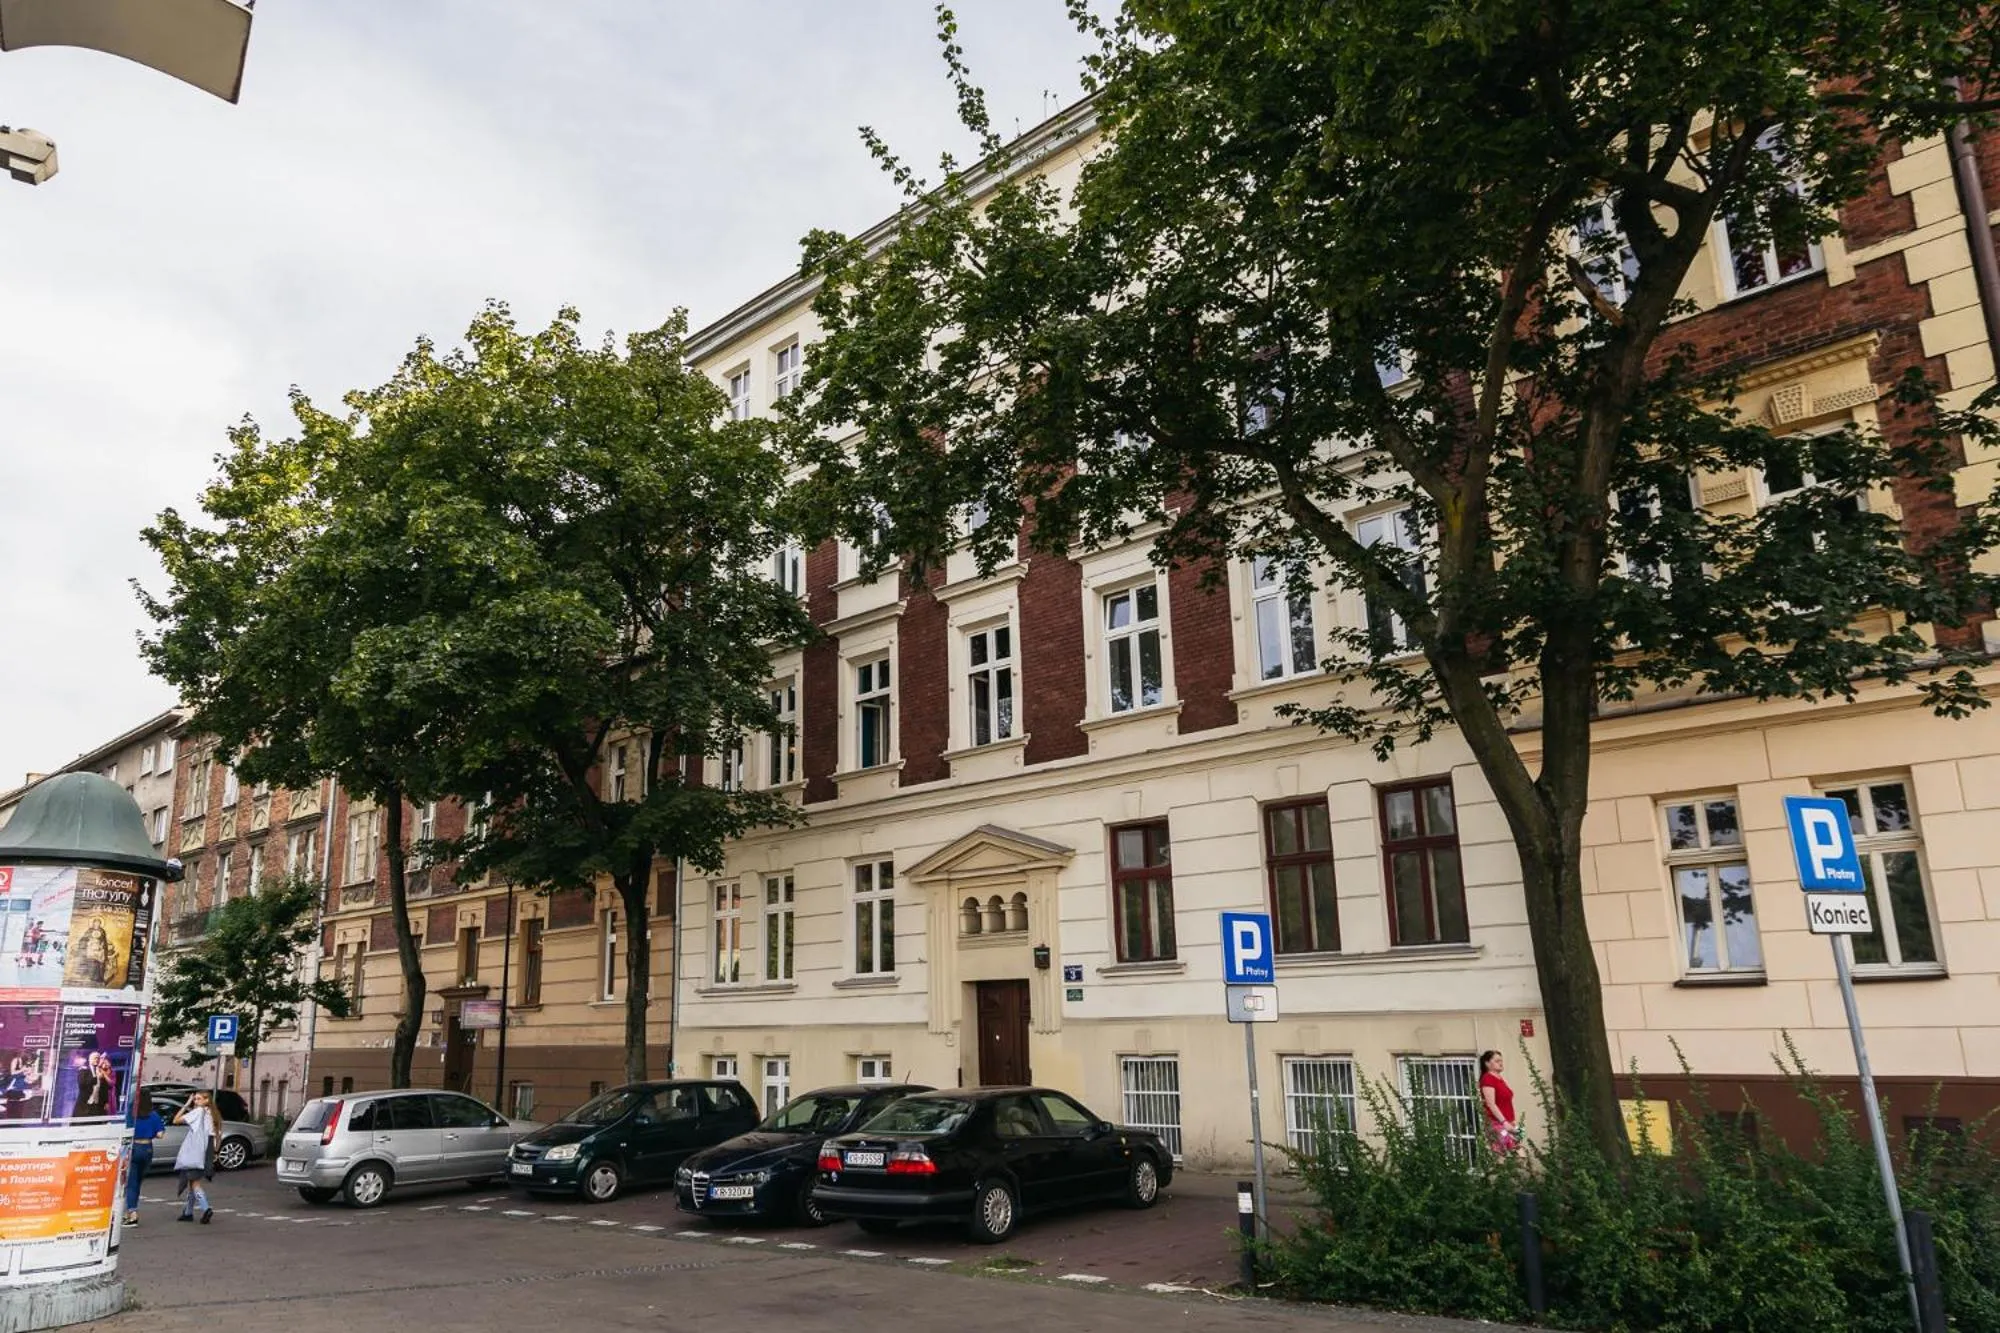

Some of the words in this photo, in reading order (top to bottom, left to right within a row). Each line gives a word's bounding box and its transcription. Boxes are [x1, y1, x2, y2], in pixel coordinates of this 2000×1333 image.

[1800, 807, 1843, 879] P
[82, 888, 132, 903] maryjny
[1811, 901, 1868, 924] Koniec
[1232, 920, 1262, 976] P
[214, 1019, 232, 1039] P
[10, 1175, 54, 1184] Польше
